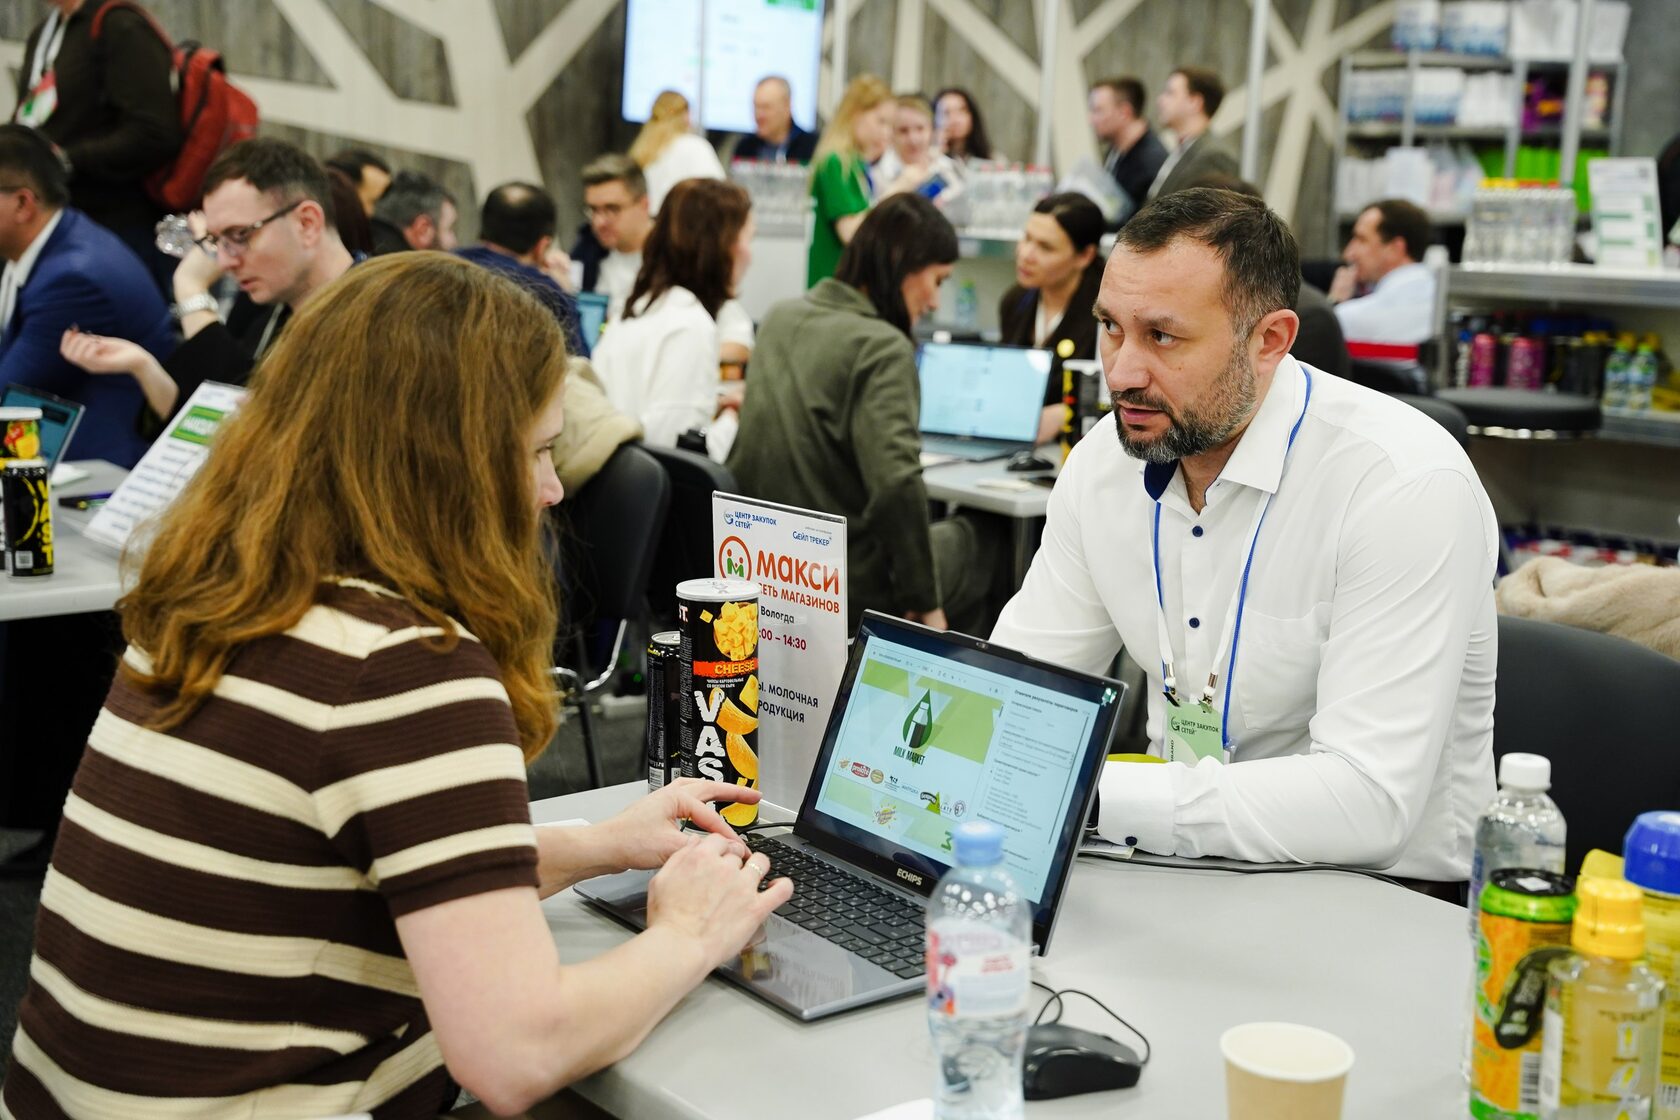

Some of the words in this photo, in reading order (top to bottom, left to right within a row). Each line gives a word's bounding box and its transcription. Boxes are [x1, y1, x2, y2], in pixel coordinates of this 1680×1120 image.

[734, 511, 752, 520] ЦЕНТР
[752, 513, 777, 526] ЗАКУПОК
[809, 535, 830, 547] ТРЕКЕР
[781, 588, 840, 614] МАГАЗИНОВ
[760, 605, 795, 624] Вологда
[783, 634, 807, 651] 14:30
[714, 660, 755, 675] CHEESE
[768, 683, 819, 708] МОЛОЧНАЯ
[758, 699, 805, 723] РОДУКЦИЯ
[1180, 719, 1196, 727] ЦЕНТР
[1196, 722, 1219, 733] ЗАКУПОК
[893, 746, 906, 759] MILK
[906, 750, 926, 766] MARKET
[896, 867, 923, 886] ECHIPS
